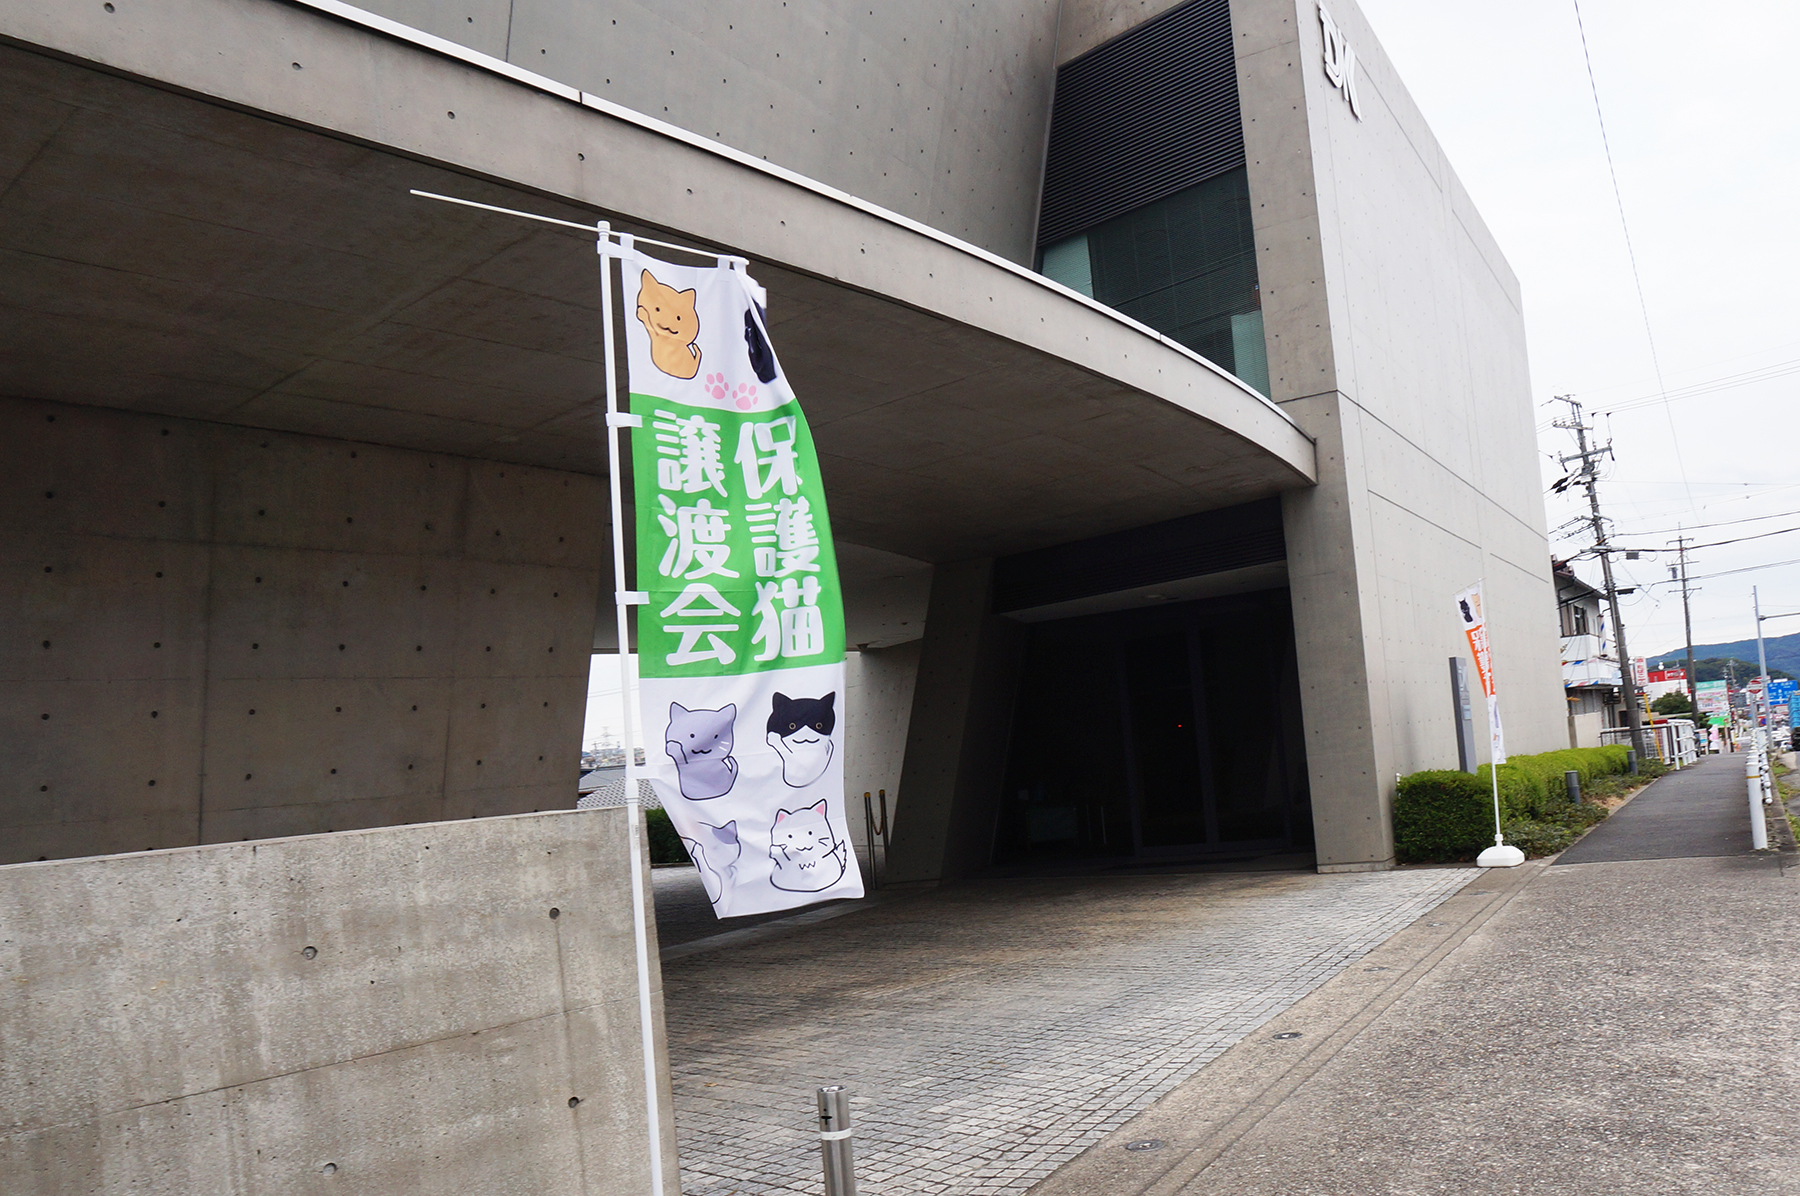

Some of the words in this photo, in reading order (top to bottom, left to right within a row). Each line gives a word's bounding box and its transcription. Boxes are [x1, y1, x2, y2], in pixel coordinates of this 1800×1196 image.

[653, 409, 741, 666] 譲渡会
[734, 415, 824, 661] 保護猫
